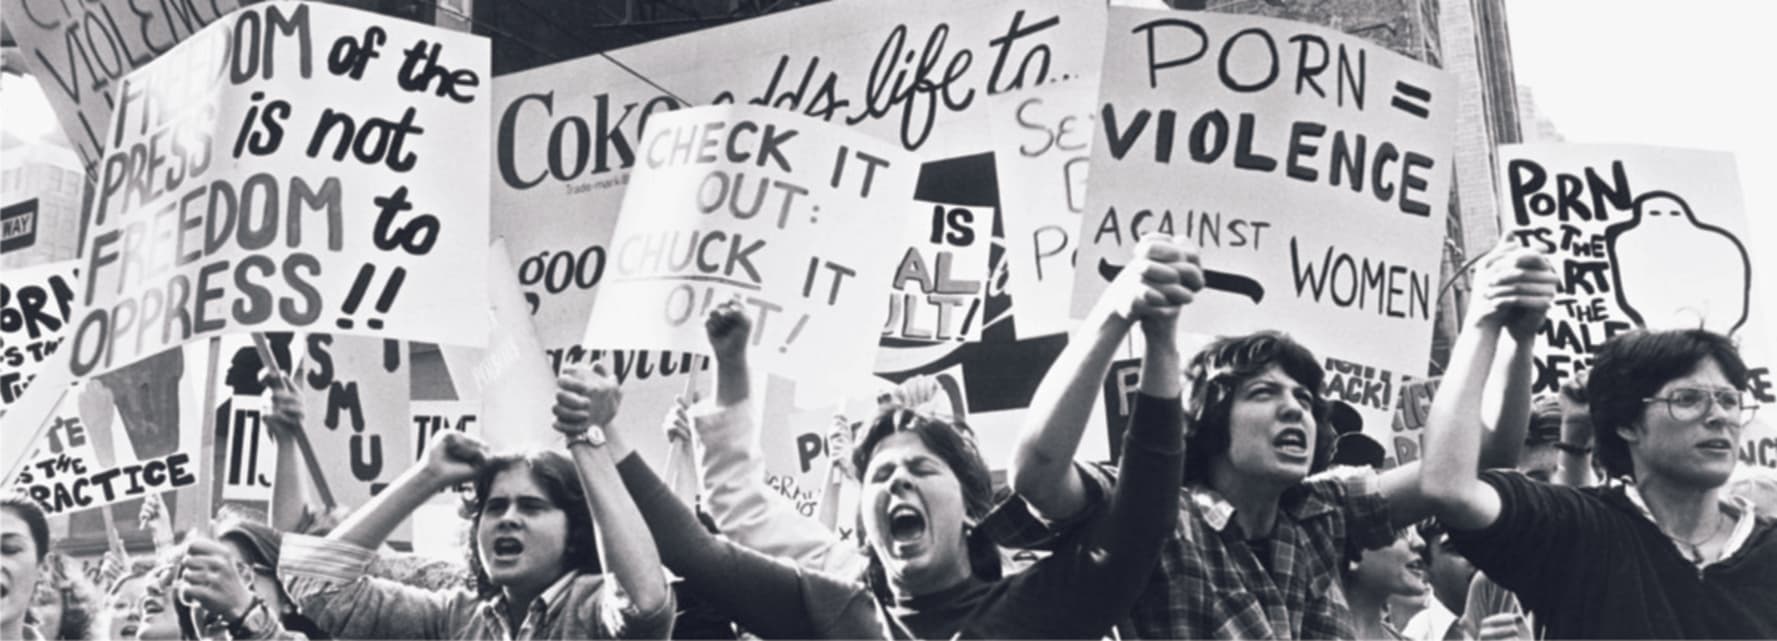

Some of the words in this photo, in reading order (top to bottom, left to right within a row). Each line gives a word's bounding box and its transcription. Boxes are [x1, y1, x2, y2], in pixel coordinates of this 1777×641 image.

[327, 26, 387, 80] of
[398, 40, 480, 103] the
[846, 23, 975, 151] life
[1132, 18, 1365, 111] PORN
[233, 92, 291, 158] is
[306, 107, 424, 172] not
[645, 120, 800, 174] CHECK
[830, 144, 891, 199] IT
[1101, 103, 1435, 217] VIOLENCE
[2, 214, 31, 238] WAY
[373, 186, 440, 255] to
[696, 169, 821, 230] OUT:
[930, 204, 976, 247] IS
[1508, 159, 1634, 226] PORN
[616, 228, 768, 285] CHUCK
[801, 255, 858, 307] IT
[1094, 205, 1271, 251] AGAINST
[1290, 236, 1430, 320] WOMEN
[1560, 224, 1606, 258] THE
[1555, 298, 1610, 322] THE
[1556, 259, 1610, 296] RT
[69, 253, 323, 377] OPPRESS
[664, 282, 811, 355] OT!
[1317, 372, 1392, 412] ACK!
[14, 453, 195, 515] RACTICE
[36, 453, 87, 490] THE
